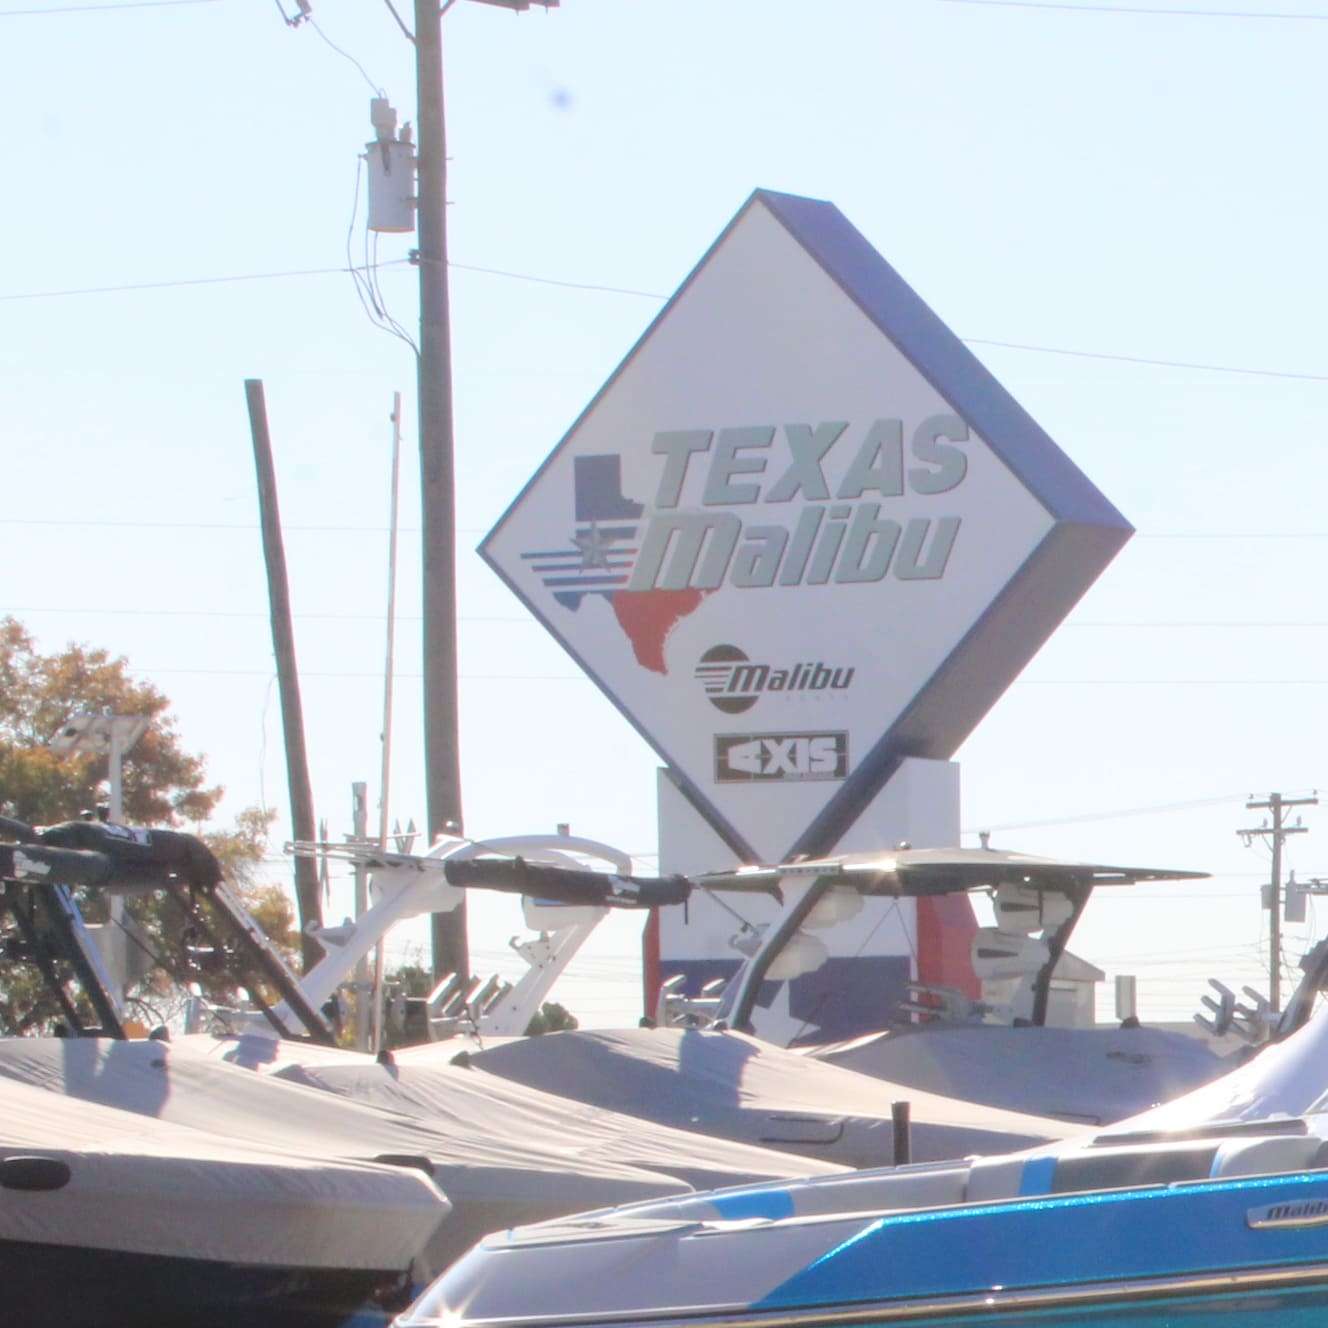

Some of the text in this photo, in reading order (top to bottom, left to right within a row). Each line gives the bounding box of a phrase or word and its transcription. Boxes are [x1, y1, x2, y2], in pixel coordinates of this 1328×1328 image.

[651, 414, 970, 509] TEXAS
[628, 504, 962, 592] Malibu
[726, 662, 855, 693] Malibu
[728, 736, 838, 774] AXIS
